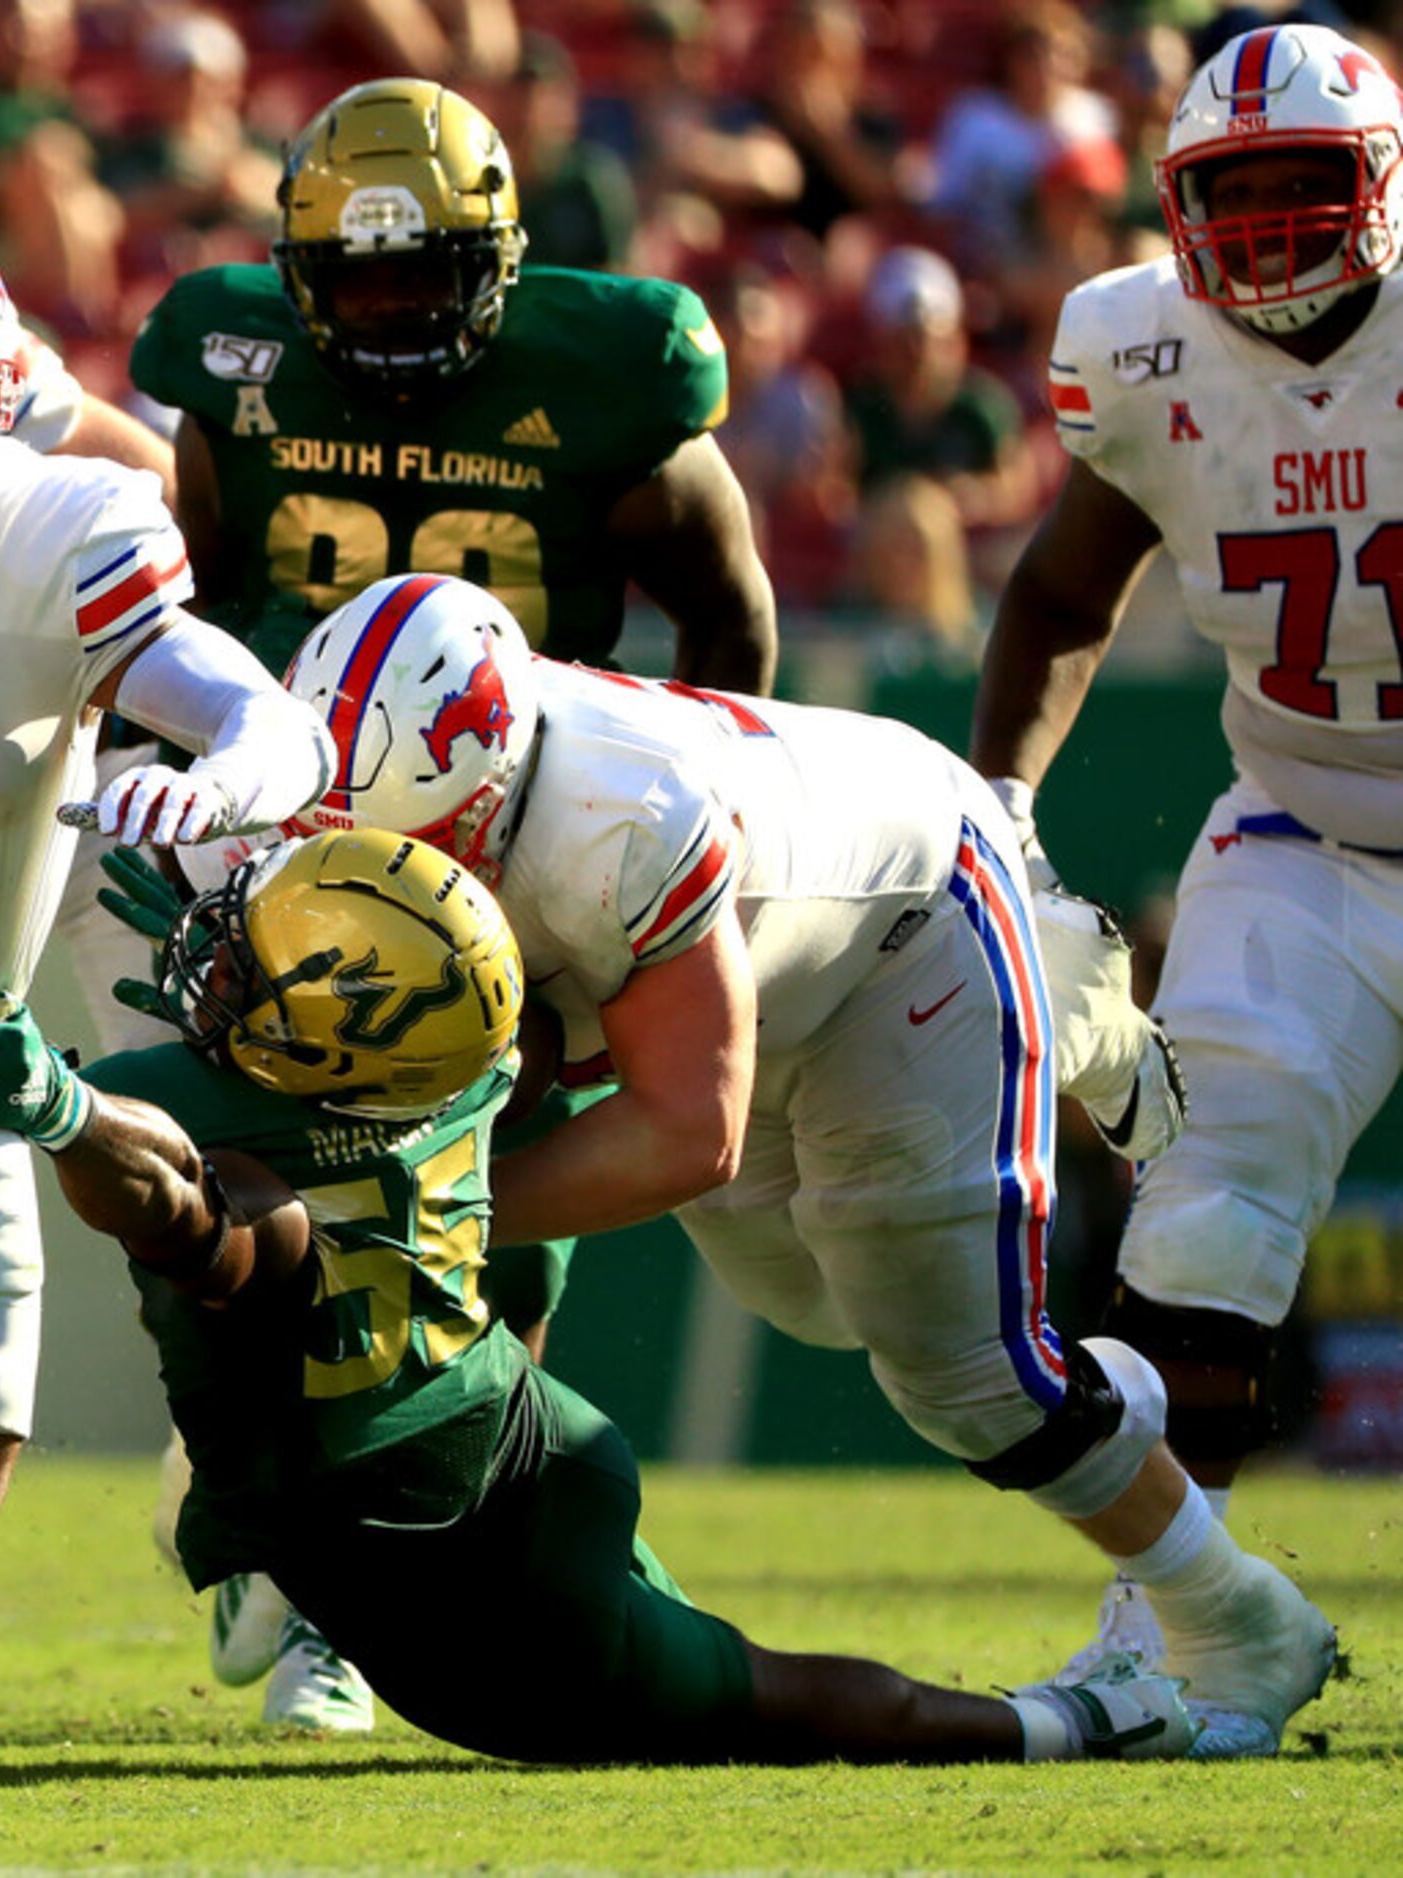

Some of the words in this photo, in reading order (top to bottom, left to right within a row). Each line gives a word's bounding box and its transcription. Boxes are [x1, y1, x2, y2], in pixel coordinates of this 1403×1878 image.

[200, 333, 280, 381] 150
[1113, 339, 1182, 386] 150
[232, 385, 279, 436] A
[1169, 401, 1203, 442] A
[270, 436, 382, 477] SOUTH
[397, 444, 544, 491] FLORIDA
[1273, 448, 1367, 516] SMU
[313, 811, 355, 831] SMU
